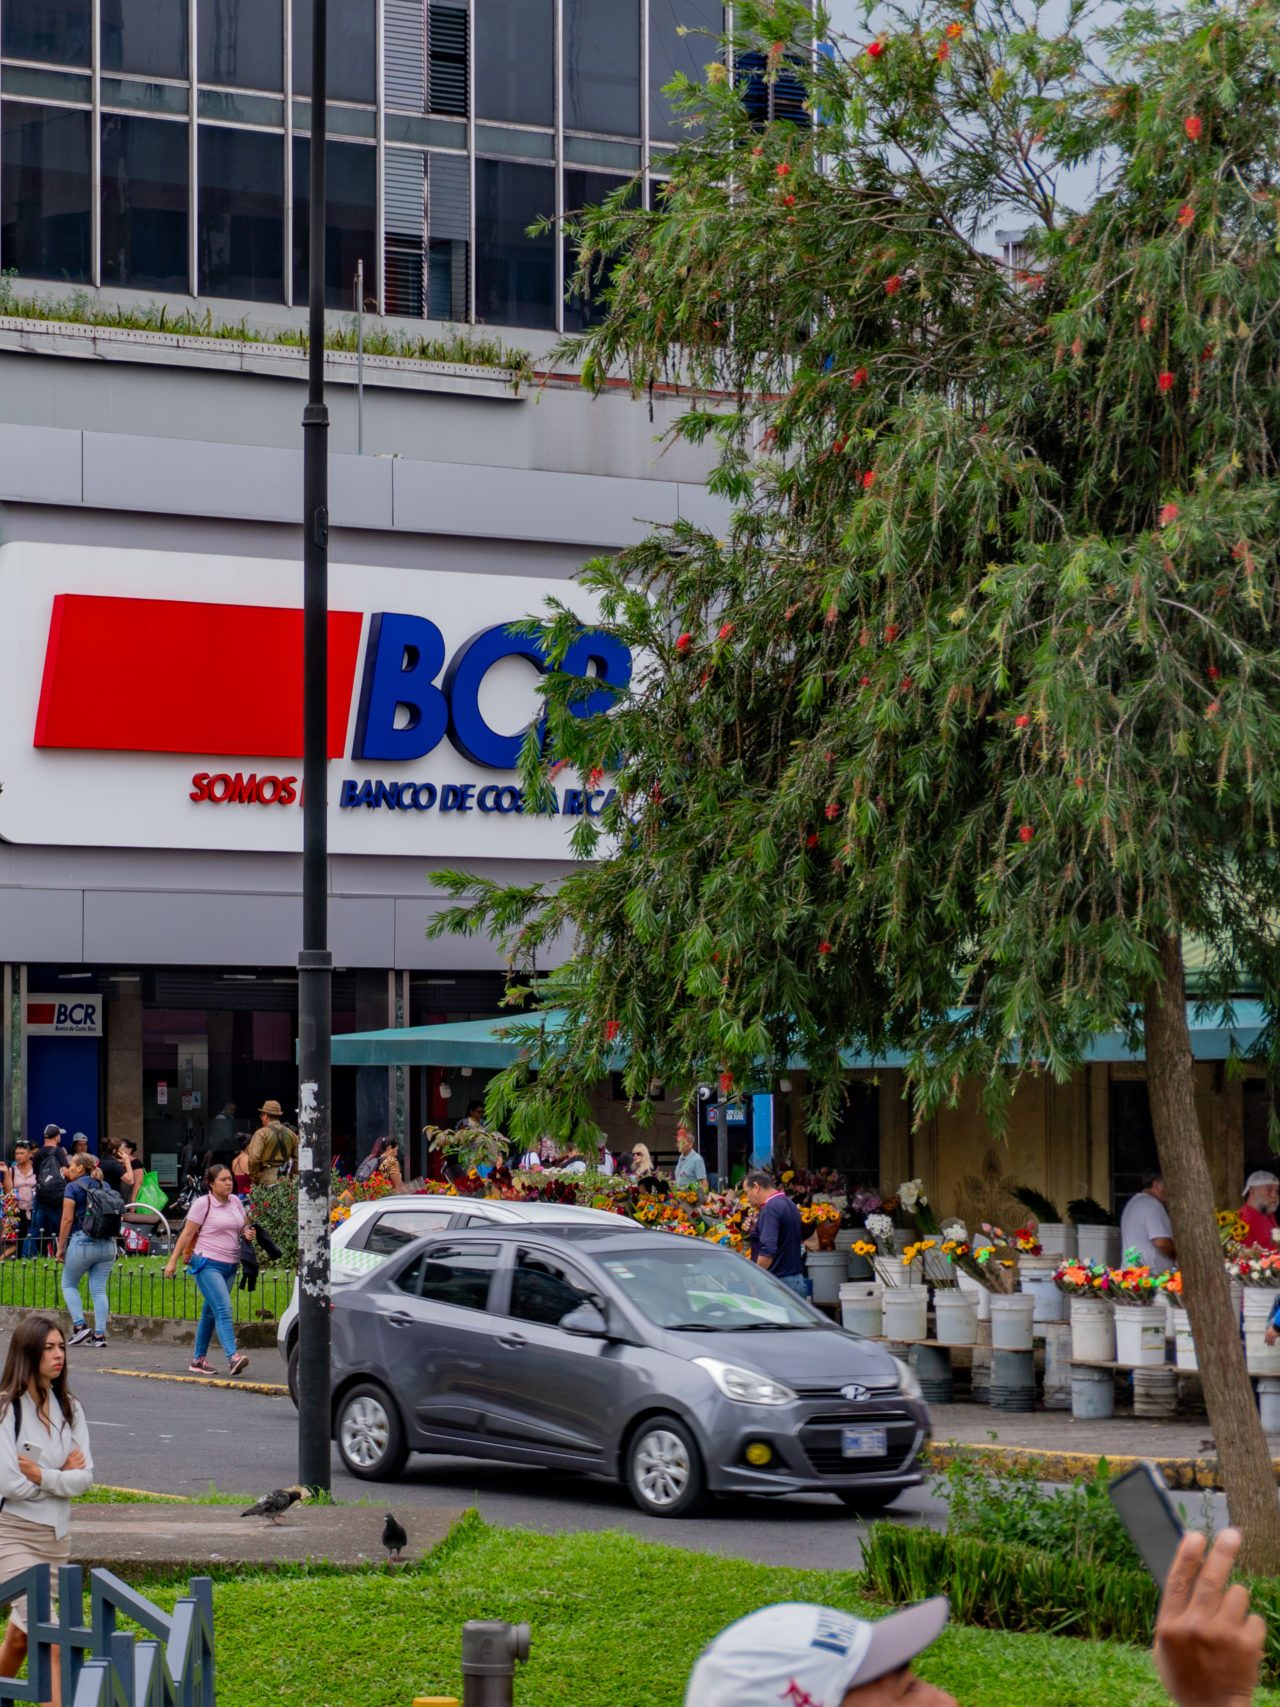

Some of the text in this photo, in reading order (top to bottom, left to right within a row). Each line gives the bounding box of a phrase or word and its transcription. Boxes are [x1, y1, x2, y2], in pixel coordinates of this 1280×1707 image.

[189, 772, 298, 805] SOMOS
[339, 779, 437, 810] BANCO
[439, 784, 477, 812] DE
[477, 784, 560, 814] COA
[56, 1003, 96, 1025] BCR
